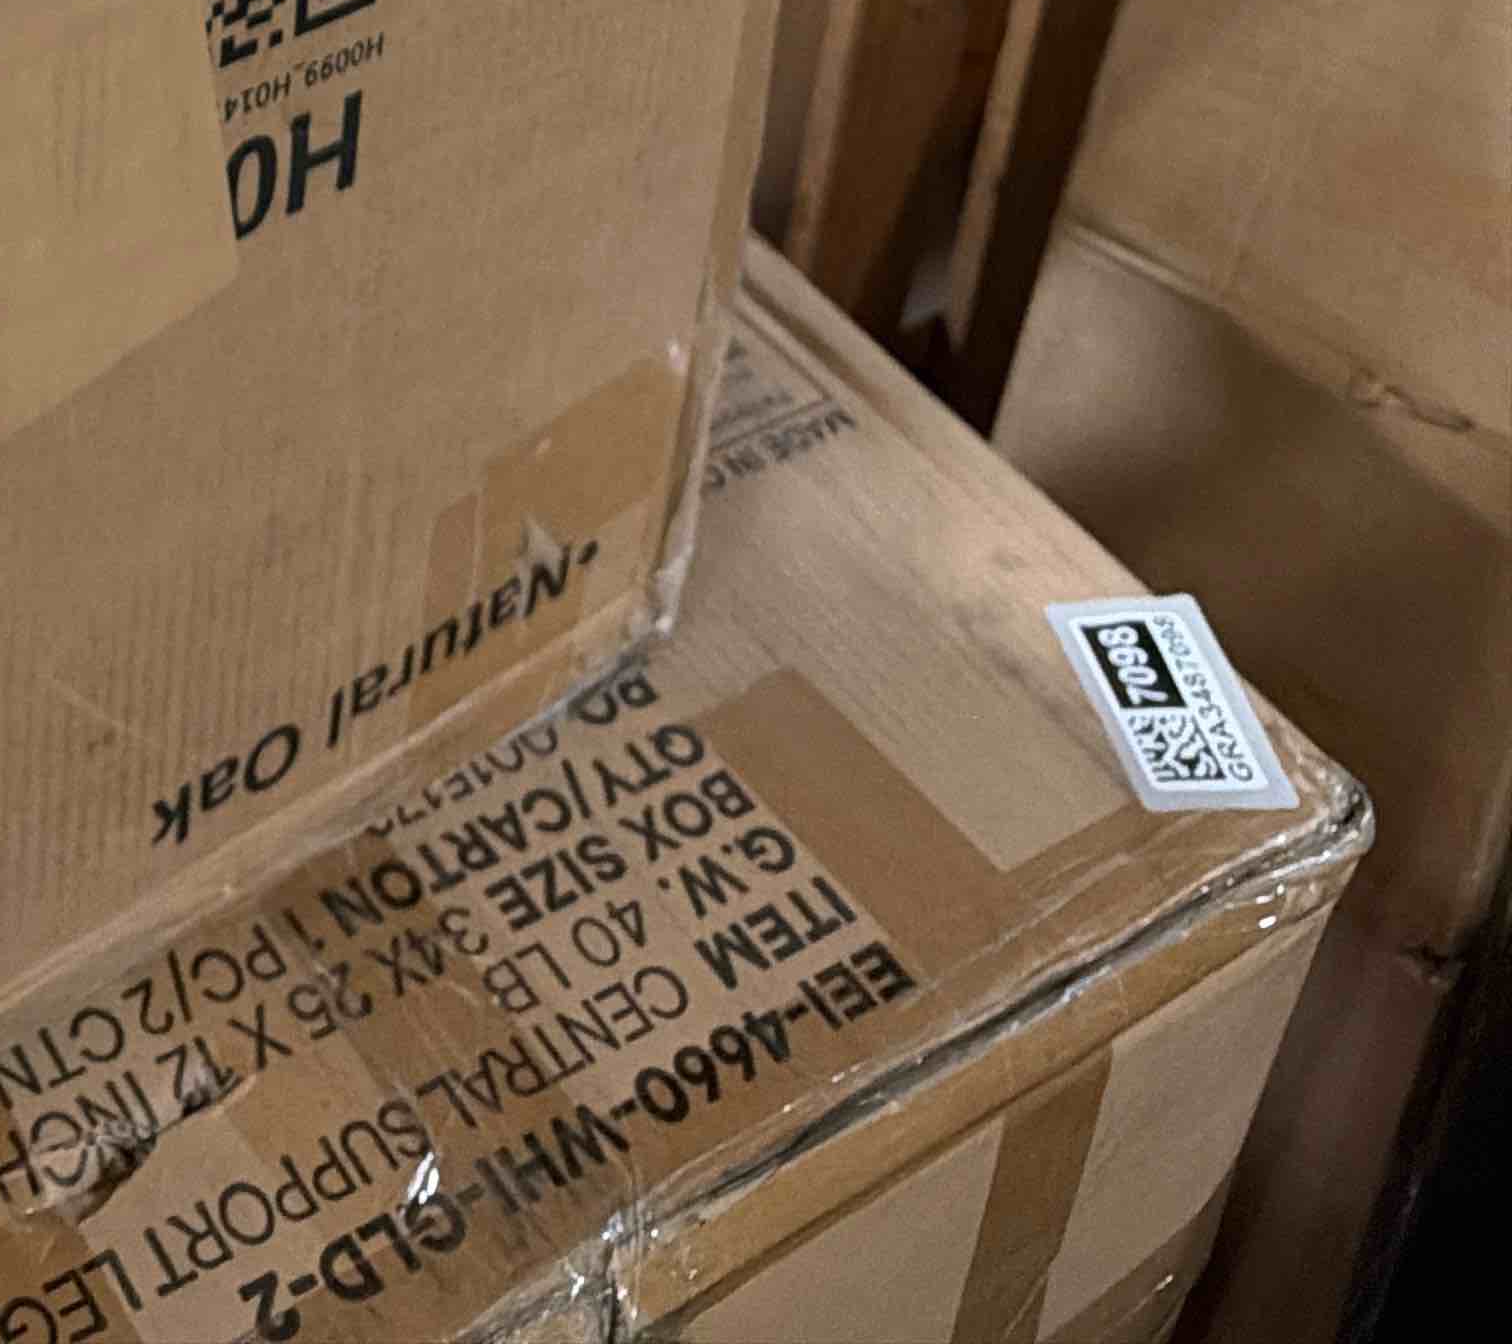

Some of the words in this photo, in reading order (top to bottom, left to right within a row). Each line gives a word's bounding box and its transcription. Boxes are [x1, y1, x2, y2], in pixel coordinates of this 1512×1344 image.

[1096, 623, 1169, 705] 7098
[151, 723, 302, 846] Oak
[318, 721, 707, 939] QTY/CARTON
[618, 769, 757, 853] BOX
[483, 830, 628, 934] SIZE
[656, 825, 796, 920] G.W.
[280, 905, 315, 951] 1
[366, 905, 489, 999] 34X
[570, 899, 649, 967] 40
[692, 874, 858, 991] ITEM
[121, 925, 288, 1037] PC/2
[289, 960, 375, 1043] 25
[482, 941, 572, 1016] LB
[153, 1035, 239, 1118] 12
[226, 1003, 294, 1072] X
[414, 962, 690, 1130] CENTRAL
[238, 941, 918, 1342] EEI-4660-WHI-GLD-2
[141, 1100, 436, 1298] SUPPORT
